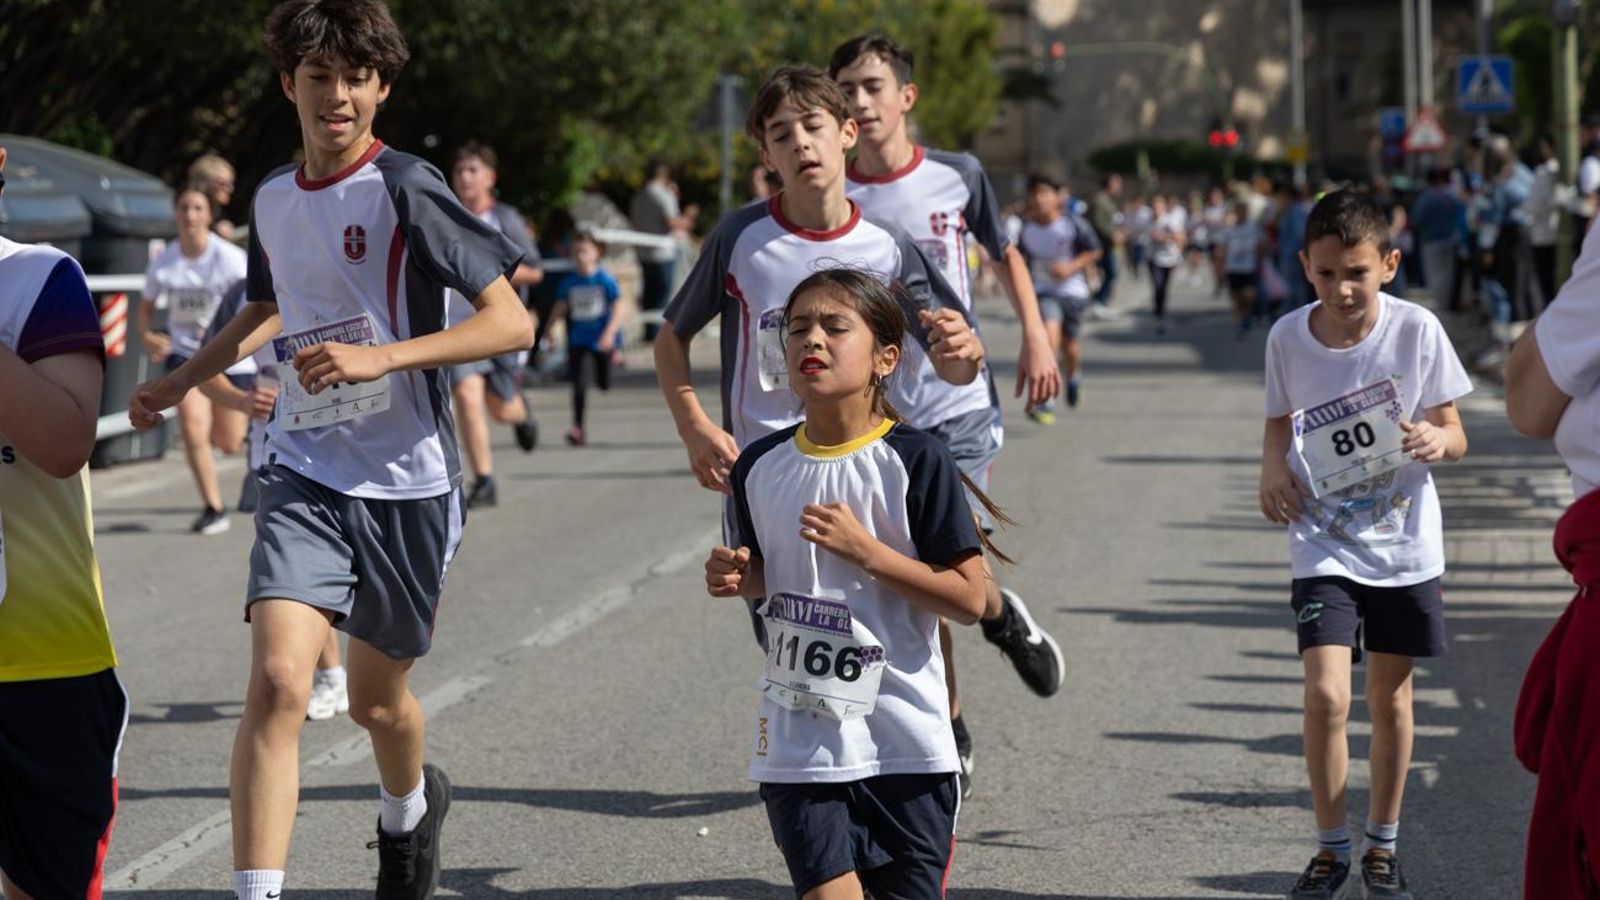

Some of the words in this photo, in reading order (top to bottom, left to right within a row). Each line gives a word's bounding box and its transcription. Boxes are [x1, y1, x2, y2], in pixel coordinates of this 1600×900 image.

[1331, 421, 1376, 457] 80
[819, 615, 830, 627] LA
[776, 631, 862, 682] 1166
[757, 717, 768, 757] MCI
